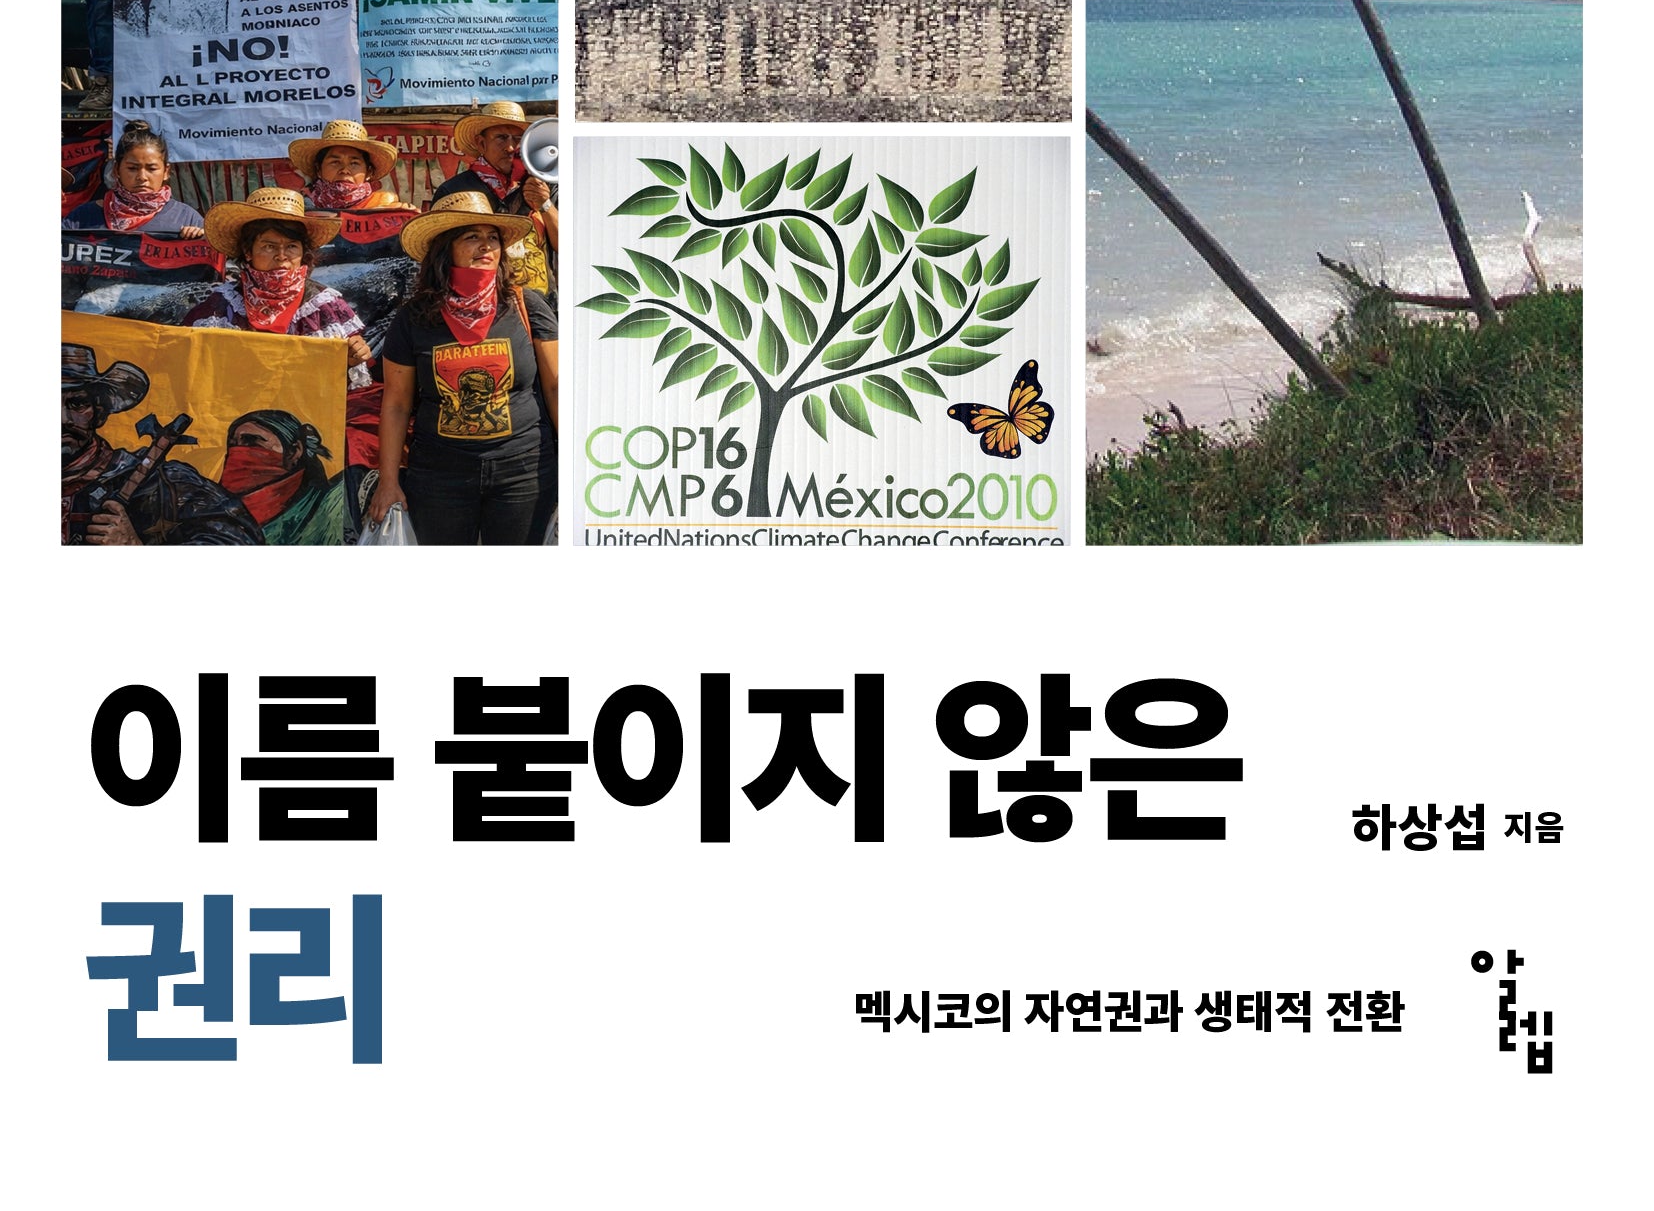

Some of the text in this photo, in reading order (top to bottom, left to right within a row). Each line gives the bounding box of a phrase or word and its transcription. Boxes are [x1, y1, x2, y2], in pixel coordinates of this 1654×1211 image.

[241, 0, 349, 17] A LOS ASENTOS
[192, 35, 289, 67] ¡NO!
[159, 75, 188, 88] AL
[215, 66, 331, 85] PROYECTO
[400, 77, 475, 89] Movimiento
[478, 75, 529, 87] Nacional
[121, 84, 356, 109] INTEGRAL MORELOS
[178, 122, 323, 139] Movimiento Nacional
[585, 425, 747, 470] COP16
[91, 673, 1243, 843] 이름 붙이지 않은
[1352, 803, 1564, 852] 하상섭 지음
[86, 895, 382, 1065] 권리
[856, 989, 1405, 1034] 멕시코의 자연권과 생태적 전환
